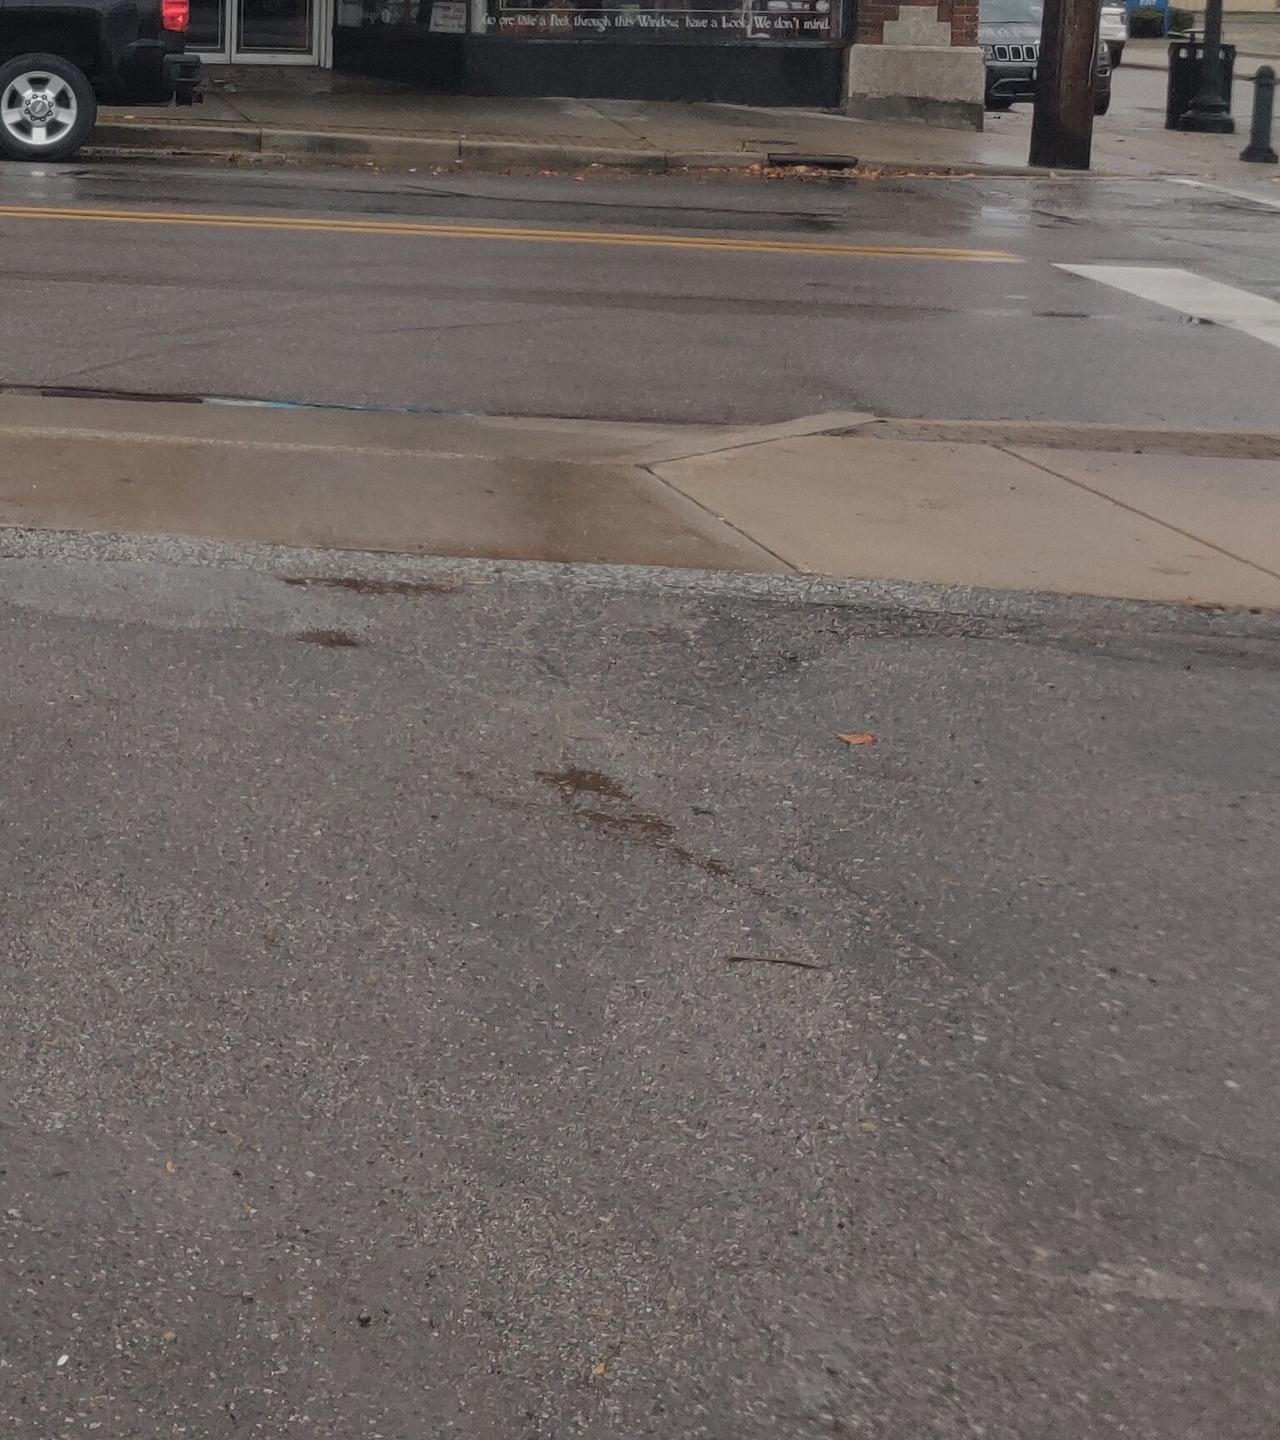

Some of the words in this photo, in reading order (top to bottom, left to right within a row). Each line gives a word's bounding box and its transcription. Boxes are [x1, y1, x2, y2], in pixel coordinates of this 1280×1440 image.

[574, 15, 611, 32] through
[754, 15, 772, 29] We
[774, 16, 800, 29] don't
